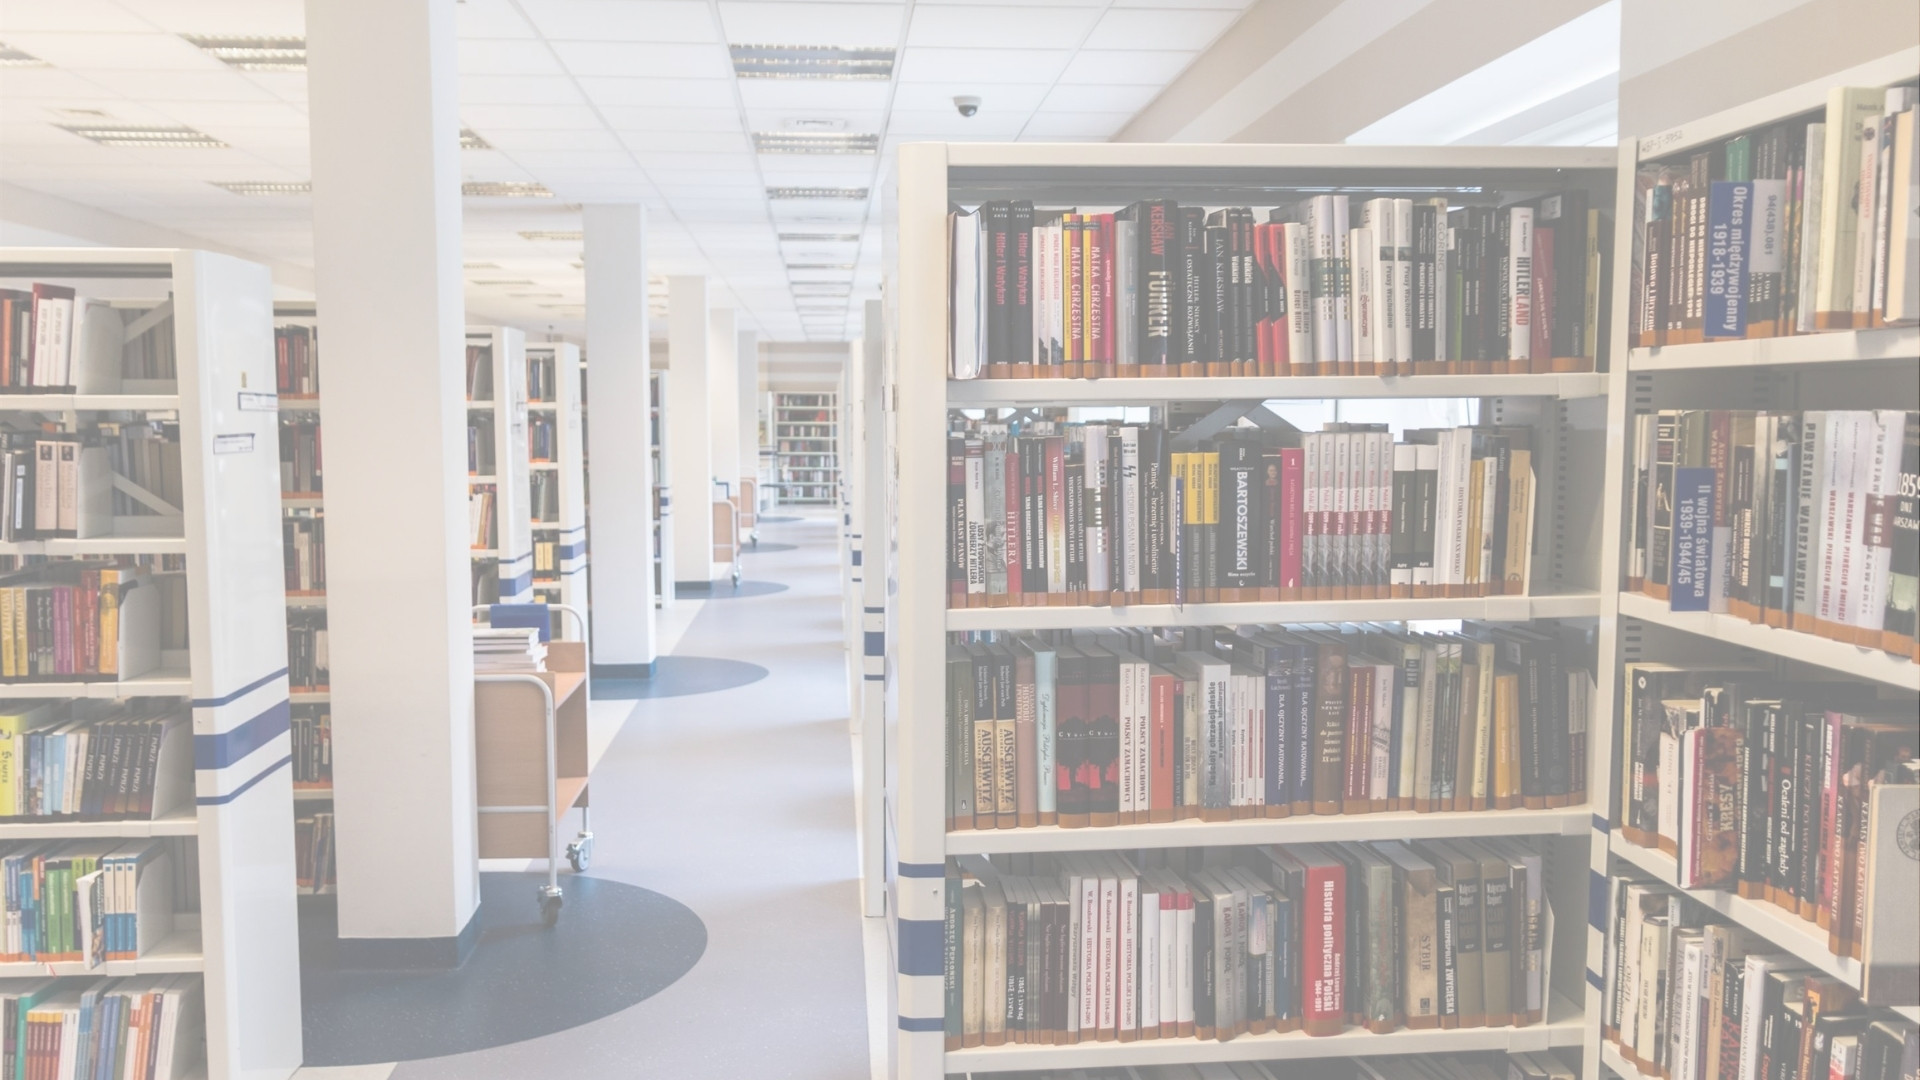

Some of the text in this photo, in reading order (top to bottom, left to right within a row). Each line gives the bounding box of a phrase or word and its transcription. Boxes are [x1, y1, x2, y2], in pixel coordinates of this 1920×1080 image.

[1151, 206, 1163, 255] KERSHAW
[1689, 227, 1695, 237] DO
[1698, 226, 1704, 236] DO
[1764, 195, 1777, 255] 94(438).081
[995, 233, 1005, 305] Hitler Watykan
[1018, 233, 1028, 305] Hitler Watykan
[1696, 240, 1704, 295] NIEPODLEGŁEJ
[1710, 223, 1727, 294] 1918-1939
[1723, 187, 1747, 330] Okres międzywojenny
[1072, 247, 1080, 339] MATKA CHRZESTNA
[1092, 247, 1100, 339] MATKA CHRZESTNA
[1148, 271, 1175, 337] FÜHRER
[1216, 263, 1224, 313] KERSHAW
[1516, 257, 1530, 325] HITLERLAND
[1126, 484, 1134, 515] HISTORIA
[1150, 463, 1158, 489] Pamięć
[1715, 472, 1724, 521] ZAMOYSKI
[1149, 498, 1158, 527] brzemię
[1237, 472, 1248, 569] BARTOSZEWSKI
[1795, 423, 1816, 602] POWSTANIE WARSZAWSKIE
[1900, 501, 1912, 512] DNI
[969, 522, 977, 556] ŻOŁNIERZY
[977, 543, 985, 584] ŻYDOWSKICH
[1007, 512, 1016, 564] HITLERA
[1128, 555, 1136, 575] NOWO
[1129, 544, 1135, 553] NA
[1455, 543, 1461, 552] XX
[1678, 499, 1693, 584] 1939-1944/45
[1694, 485, 1711, 596] II wojna światowa
[1821, 490, 1836, 616] WARSZAWSKI PIERŚCIEŃ ŚMIERCI
[1838, 492, 1855, 620] WARSZAWSKI PIERŚCIEŃ ŚMIERCI
[2, 593, 11, 640] WOJTYŁA
[16, 593, 24, 640] WOJTYŁA
[1208, 681, 1217, 785] Kościoły chrześcijańskie
[1300, 708, 1308, 738] OJCZYZNY
[1825, 724, 1833, 754] ROBERT
[982, 729, 993, 803] AUSCHWITZ
[1004, 729, 1014, 803] AUSCHWITZ
[1804, 754, 1812, 798] KLUCZE
[1719, 784, 1734, 831] KRESY
[1778, 779, 1791, 875] Ocaleni od zagłady
[1803, 804, 1810, 823] DO
[1831, 796, 1843, 920] KŁAMSTWO KATYŃSKIE
[1855, 802, 1868, 928] KŁAMSTWO KATYŃSKIE
[1323, 881, 1334, 1011] Historia polityczna Polski
[1421, 936, 1431, 971] SYBIR
[1445, 968, 1454, 1013] ZWYCIĘSKA
[1674, 949, 1684, 1026] HANNA KRALL
[1741, 1005, 1750, 1063] ZAPOMNIANY
